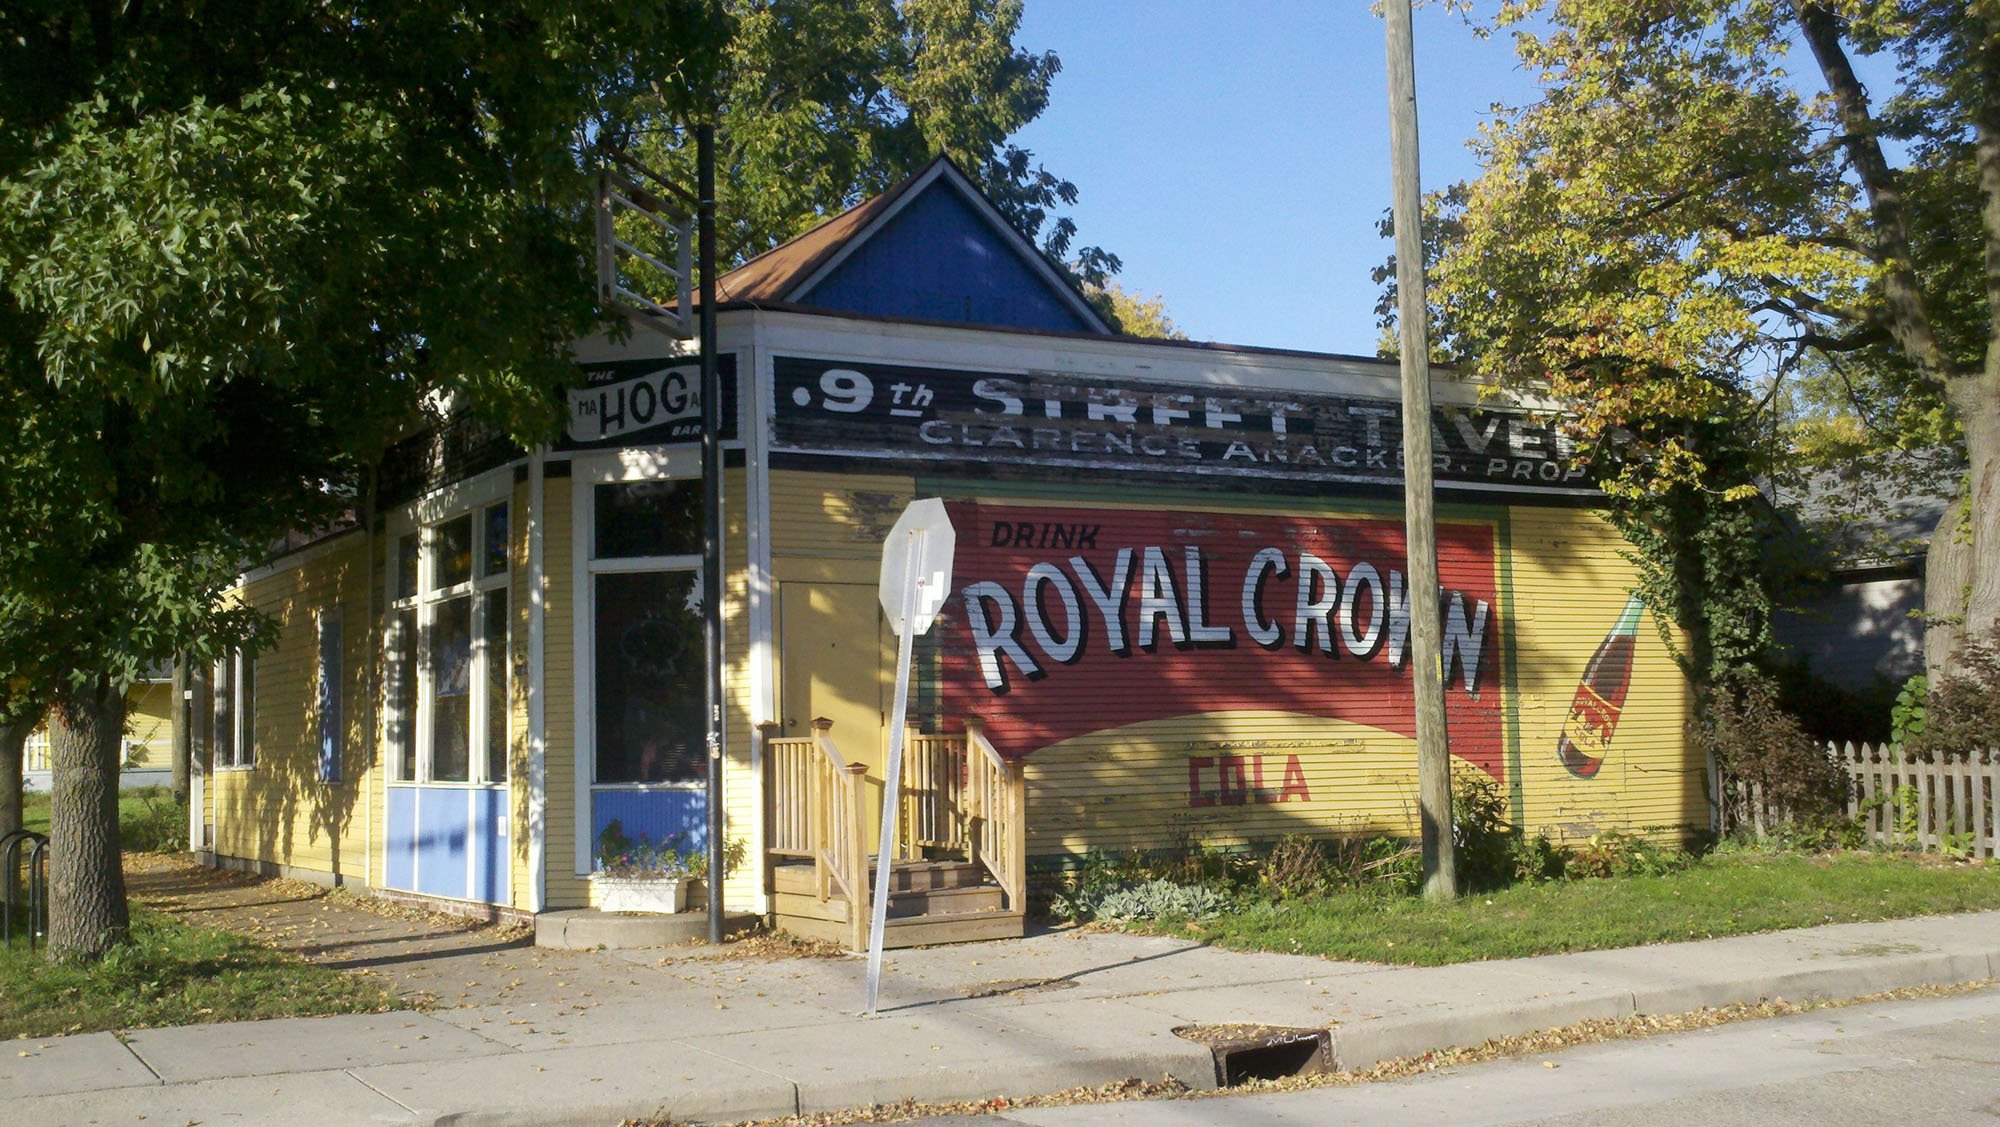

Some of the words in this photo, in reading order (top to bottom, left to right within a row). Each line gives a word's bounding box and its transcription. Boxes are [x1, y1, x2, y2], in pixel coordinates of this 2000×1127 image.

[586, 371, 615, 382] THE
[672, 425, 702, 437] BAR
[919, 419, 1202, 459] CLARENCE
[992, 520, 1101, 550] DRINK
[962, 545, 1234, 692] ROYAL
[1188, 754, 1311, 807] COLA
